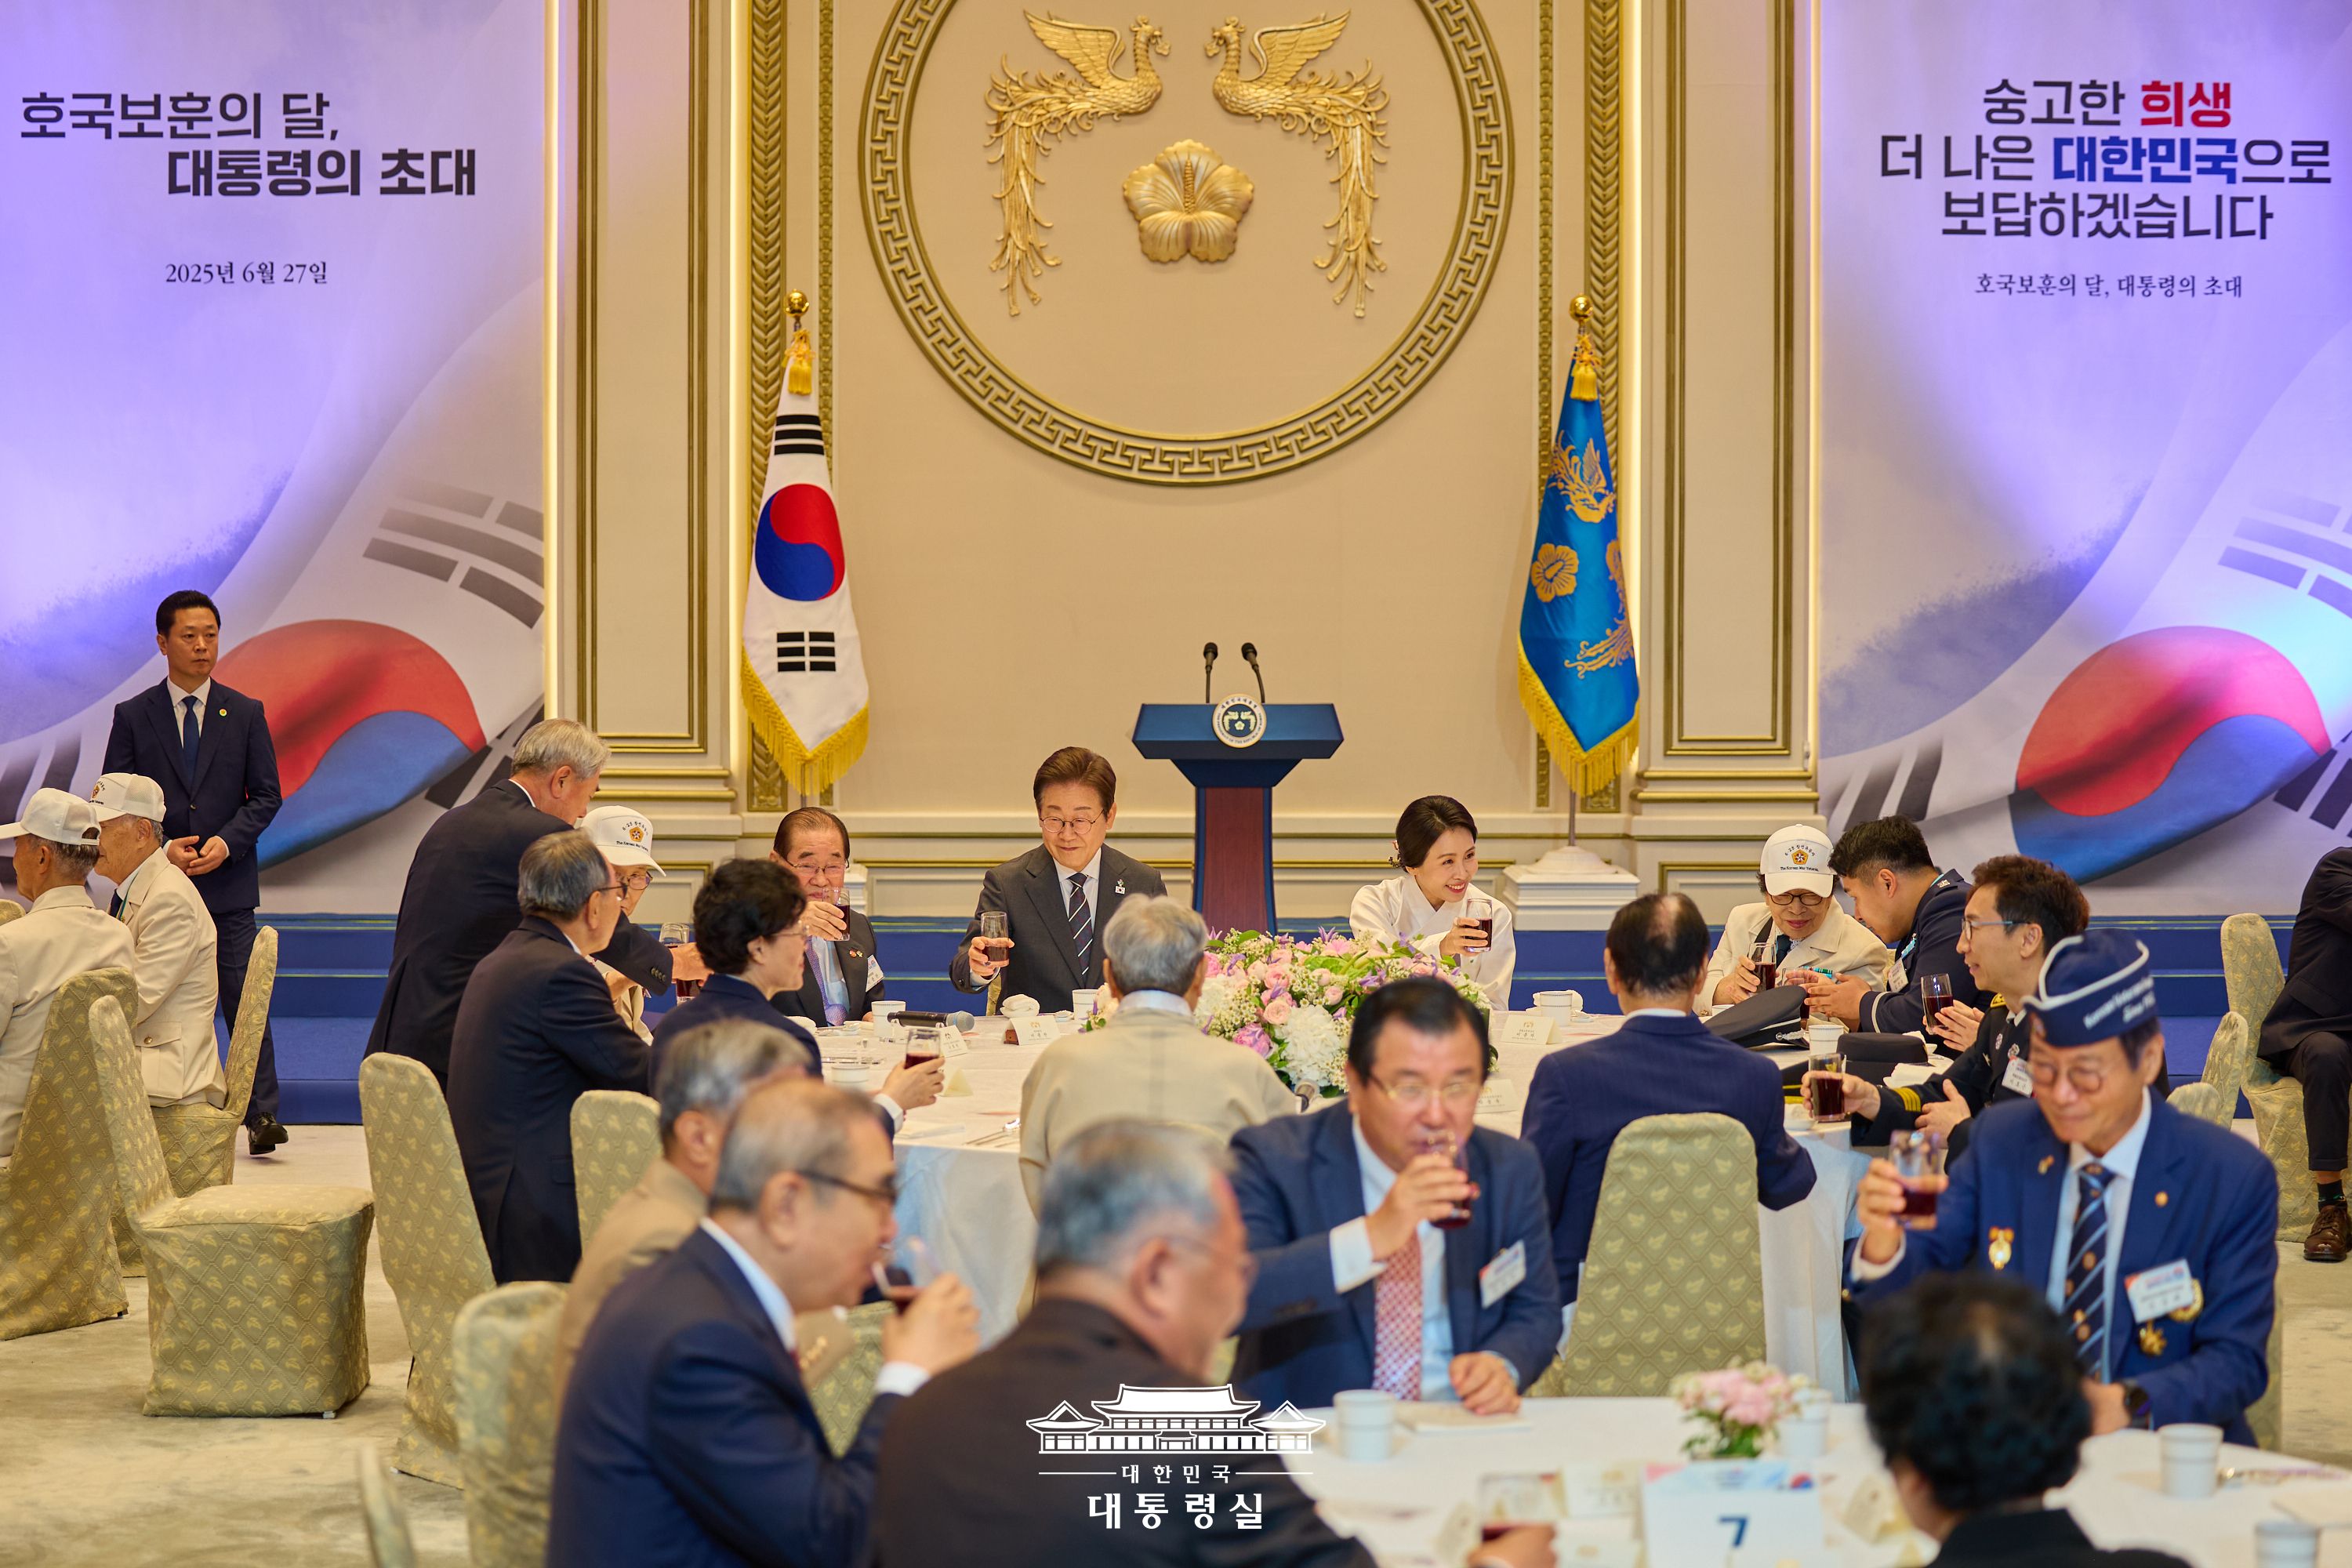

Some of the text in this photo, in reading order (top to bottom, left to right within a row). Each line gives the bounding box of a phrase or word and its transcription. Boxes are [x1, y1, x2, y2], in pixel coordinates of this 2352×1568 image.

[21, 92, 339, 141] 호국보훈의 달,
[1984, 78, 2231, 128] 숭고한 희생
[168, 148, 476, 197] 대통령의 초대
[1881, 133, 2332, 184] 더 나은 대한민국으로
[1942, 191, 2274, 240] 보답하겠습니다
[165, 261, 327, 284] 2025년 6월 27일
[1975, 273, 2241, 298] 호국보훈의 달, 대통령의 초대
[1720, 1515, 1749, 1548] 7
